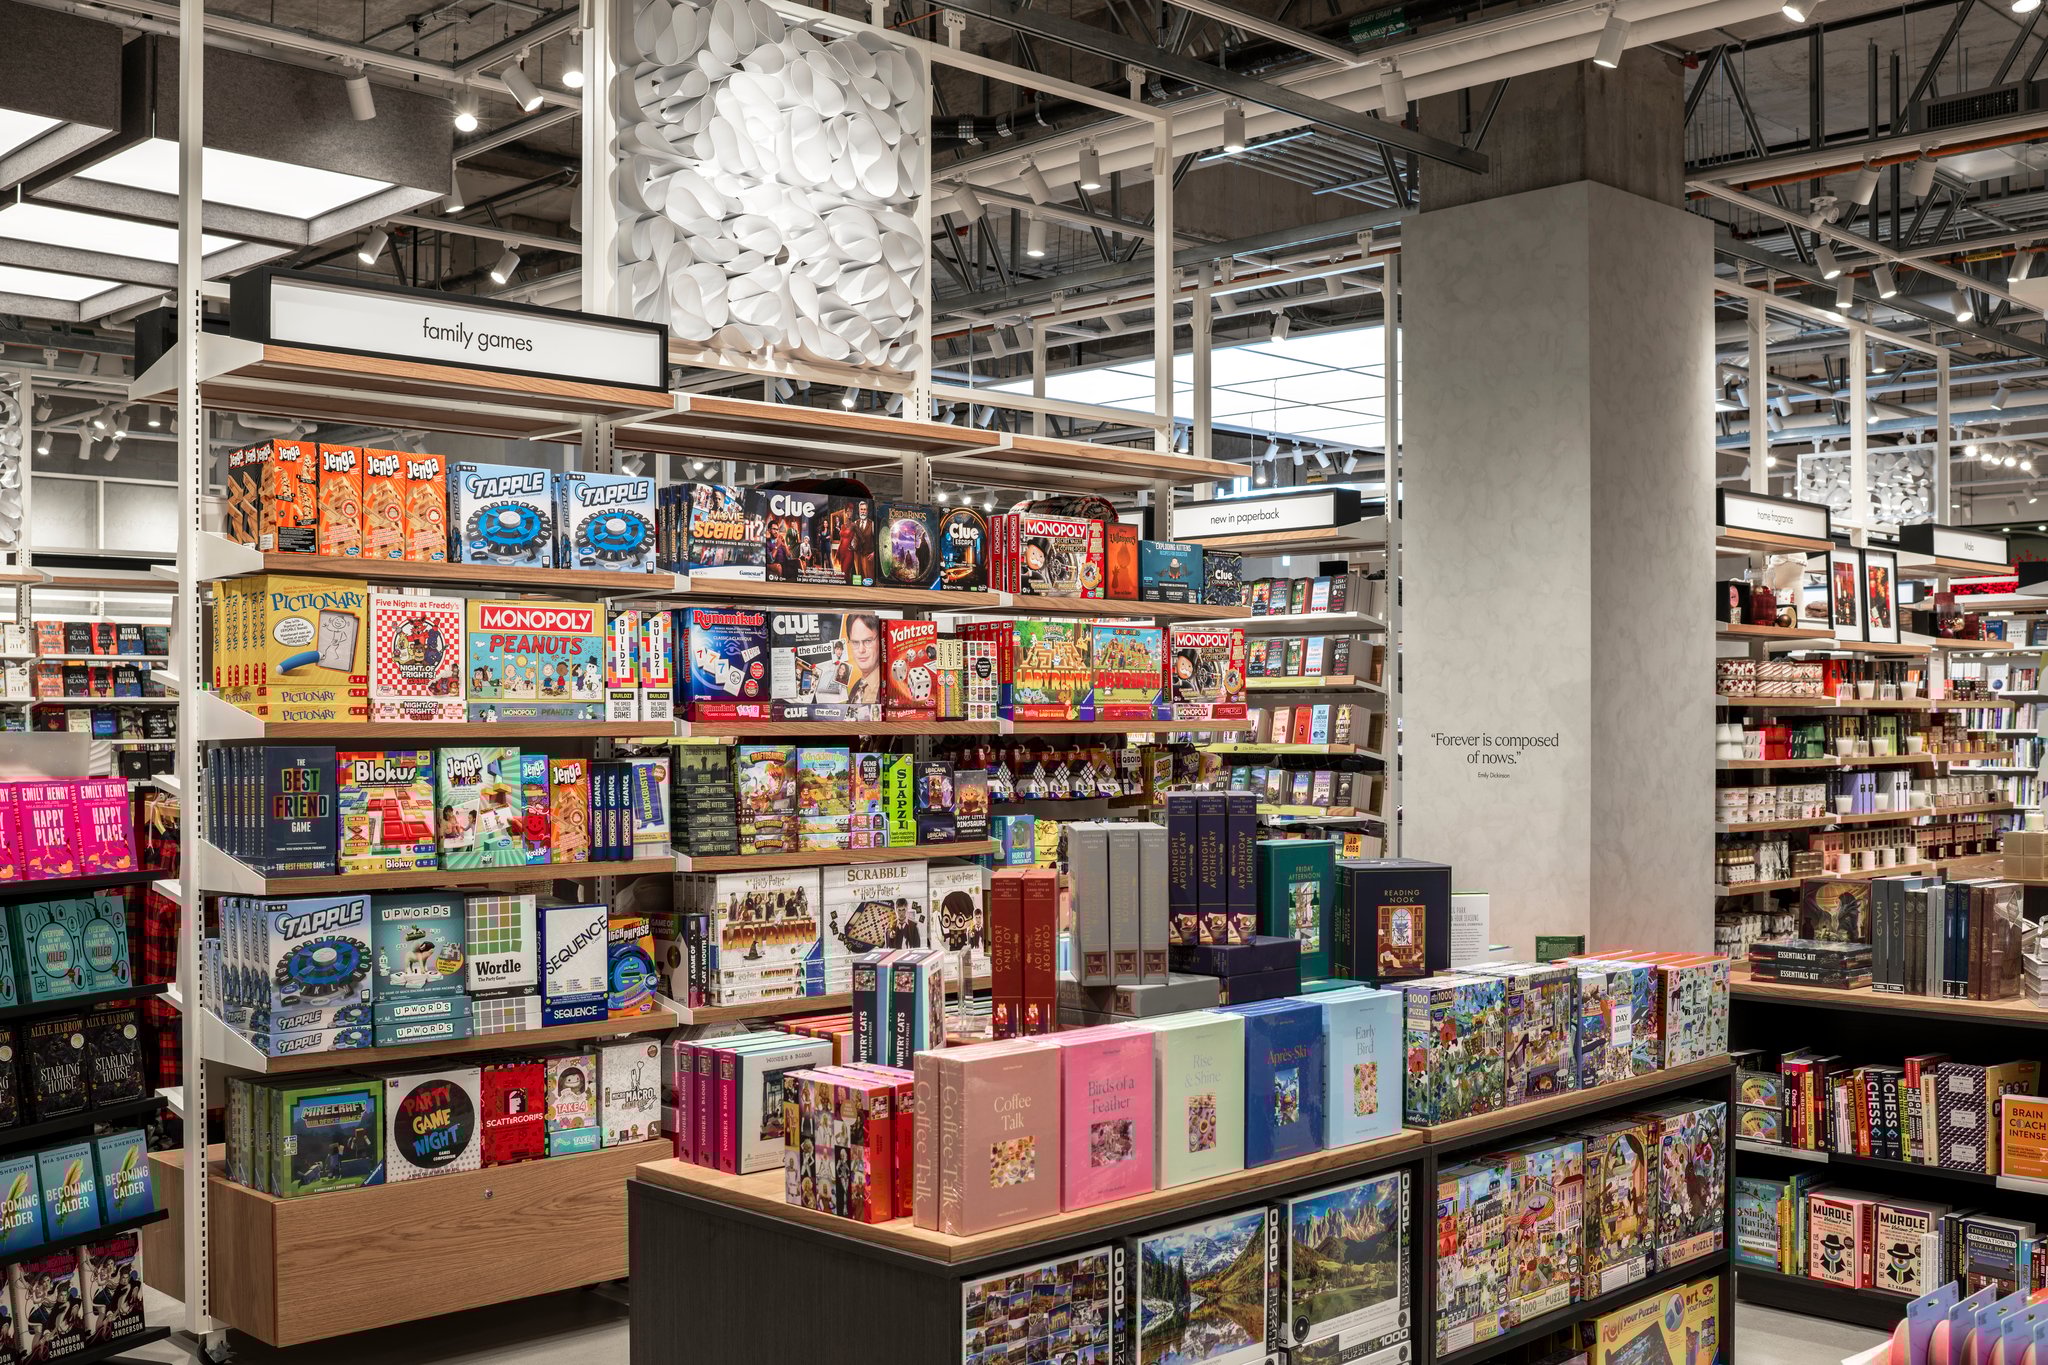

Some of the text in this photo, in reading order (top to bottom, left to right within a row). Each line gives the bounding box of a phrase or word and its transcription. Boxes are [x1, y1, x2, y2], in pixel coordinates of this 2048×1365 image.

[422, 317, 533, 352] family games
[323, 450, 356, 472] Jenga
[407, 458, 439, 480] Jenga
[474, 473, 544, 499] TAPPLE
[770, 494, 816, 518] Clue
[710, 511, 744, 521] MOVIE
[1210, 508, 1279, 525] new in paperback
[1757, 510, 1794, 526] home fragrance
[693, 521, 744, 540] scene
[949, 523, 979, 540] Clue
[1025, 522, 1086, 537] MONOPOLY
[1156, 542, 1177, 551] EXPLODING
[1215, 570, 1232, 580] Clue
[270, 589, 365, 611] PICTIONARY
[376, 599, 459, 611] Five Nights at Freddy's
[483, 610, 591, 630] MONOPOLY
[693, 610, 764, 628] Rummikub
[772, 614, 820, 635] CLUE
[890, 624, 934, 642] Yahtzee
[489, 635, 583, 655] PEANUTS
[798, 644, 832, 655] the office
[400, 665, 421, 673] NIGHT
[402, 671, 436, 679] FRIGHTS!
[1016, 669, 1091, 690] LABYRINTH
[1431, 733, 1559, 750] “Forever is composed
[447, 753, 481, 778] Jenga
[1467, 750, 1521, 764] of nows.”
[355, 761, 416, 782] Blokus
[451, 775, 481, 785] MAKER
[284, 769, 319, 792] BEST
[22, 785, 69, 801] EMILY HENRY
[640, 767, 651, 820] BLOCKBUSTER
[276, 795, 327, 818] FRIEND
[33, 810, 64, 828] HAPPY
[291, 822, 311, 832] GAME
[36, 830, 67, 847] PLACE
[847, 867, 907, 882] SCRABBLE
[284, 901, 364, 940] TAPPLE
[382, 905, 450, 920] UPWORDS
[546, 915, 608, 975] SEQUENCE
[691, 945, 695, 956] OF
[1778, 951, 1806, 961] ESSENTIALS
[476, 958, 521, 975] Wordle
[1514, 978, 1529, 990] 1000
[1408, 994, 1428, 1005] 1000
[1408, 1008, 1428, 1016] PUZZLE
[54, 1019, 83, 1035] HARROW
[1355, 1026, 1376, 1040] Early
[1268, 1046, 1307, 1065] Après-Ski
[1357, 1042, 1374, 1056] Bird
[40, 1063, 81, 1083] STARLING
[48, 1076, 77, 1094] HOUSE
[1088, 1080, 1114, 1097] Birds
[1116, 1077, 1128, 1093] of
[303, 1101, 366, 1118] MINECRAFT
[403, 1087, 450, 1116] PARTY
[557, 1102, 587, 1113] TAKE 4
[993, 1095, 1032, 1114] Coffee
[1092, 1096, 1131, 1113] Feather
[1867, 1082, 1881, 1126] CHESS
[413, 1109, 450, 1134] GAME
[486, 1113, 543, 1128] SCATTERGORIES
[2012, 1108, 2043, 1119] BRAIN
[1002, 1116, 1025, 1131] Talk
[413, 1125, 458, 1156] NIGHT
[2009, 1129, 2047, 1141] INTENSE
[56, 1151, 88, 1162] SHERIDAN
[46, 1180, 94, 1202] BECOMING
[55, 1196, 90, 1215] CALDER
[1880, 1212, 1925, 1229] MURDLE
[1115, 1246, 1124, 1316] 1000
[1545, 1288, 1569, 1306] PUZZLE
[111, 1321, 143, 1338] SANDERSON
[114, 1314, 140, 1329] BRANDON
